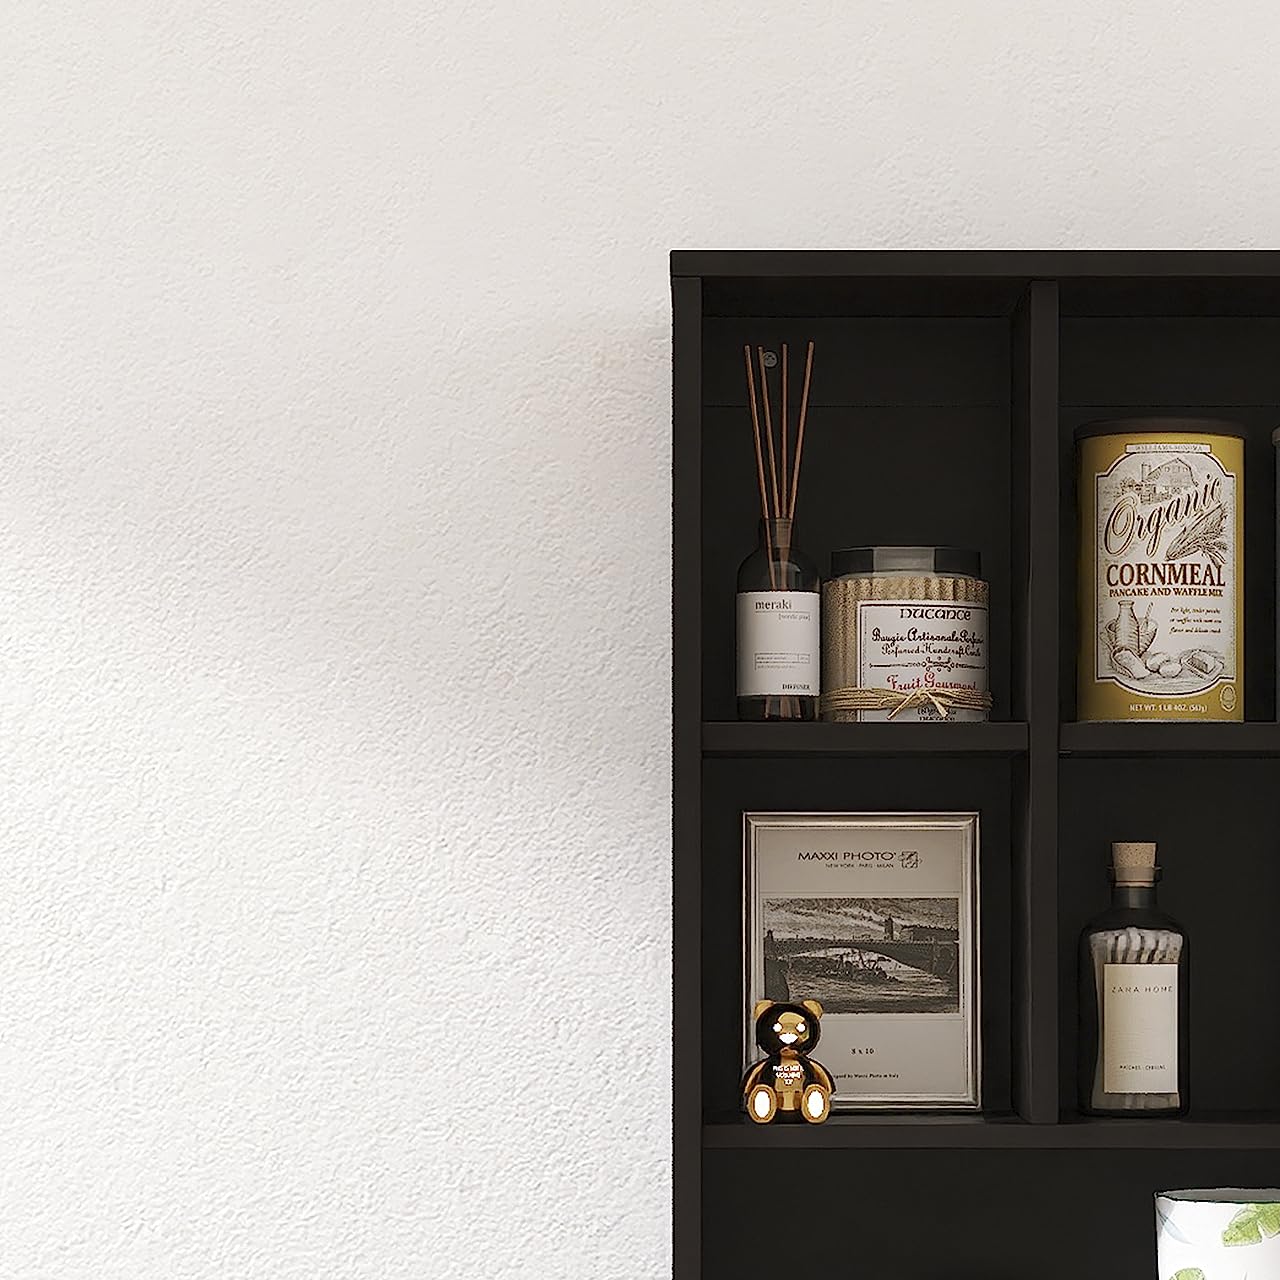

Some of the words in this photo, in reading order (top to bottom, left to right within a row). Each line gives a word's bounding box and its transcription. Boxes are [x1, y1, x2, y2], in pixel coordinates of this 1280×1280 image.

[1104, 474, 1221, 557] Organic
[1107, 563, 1226, 587] CORNMEAL
[1110, 588, 1148, 598] PANCAKE
[1150, 588, 1171, 597] AND
[1173, 588, 1208, 598] WAFFLE
[1208, 589, 1223, 598] MIX
[755, 599, 792, 609] meraki
[798, 852, 838, 860] MAXXI
